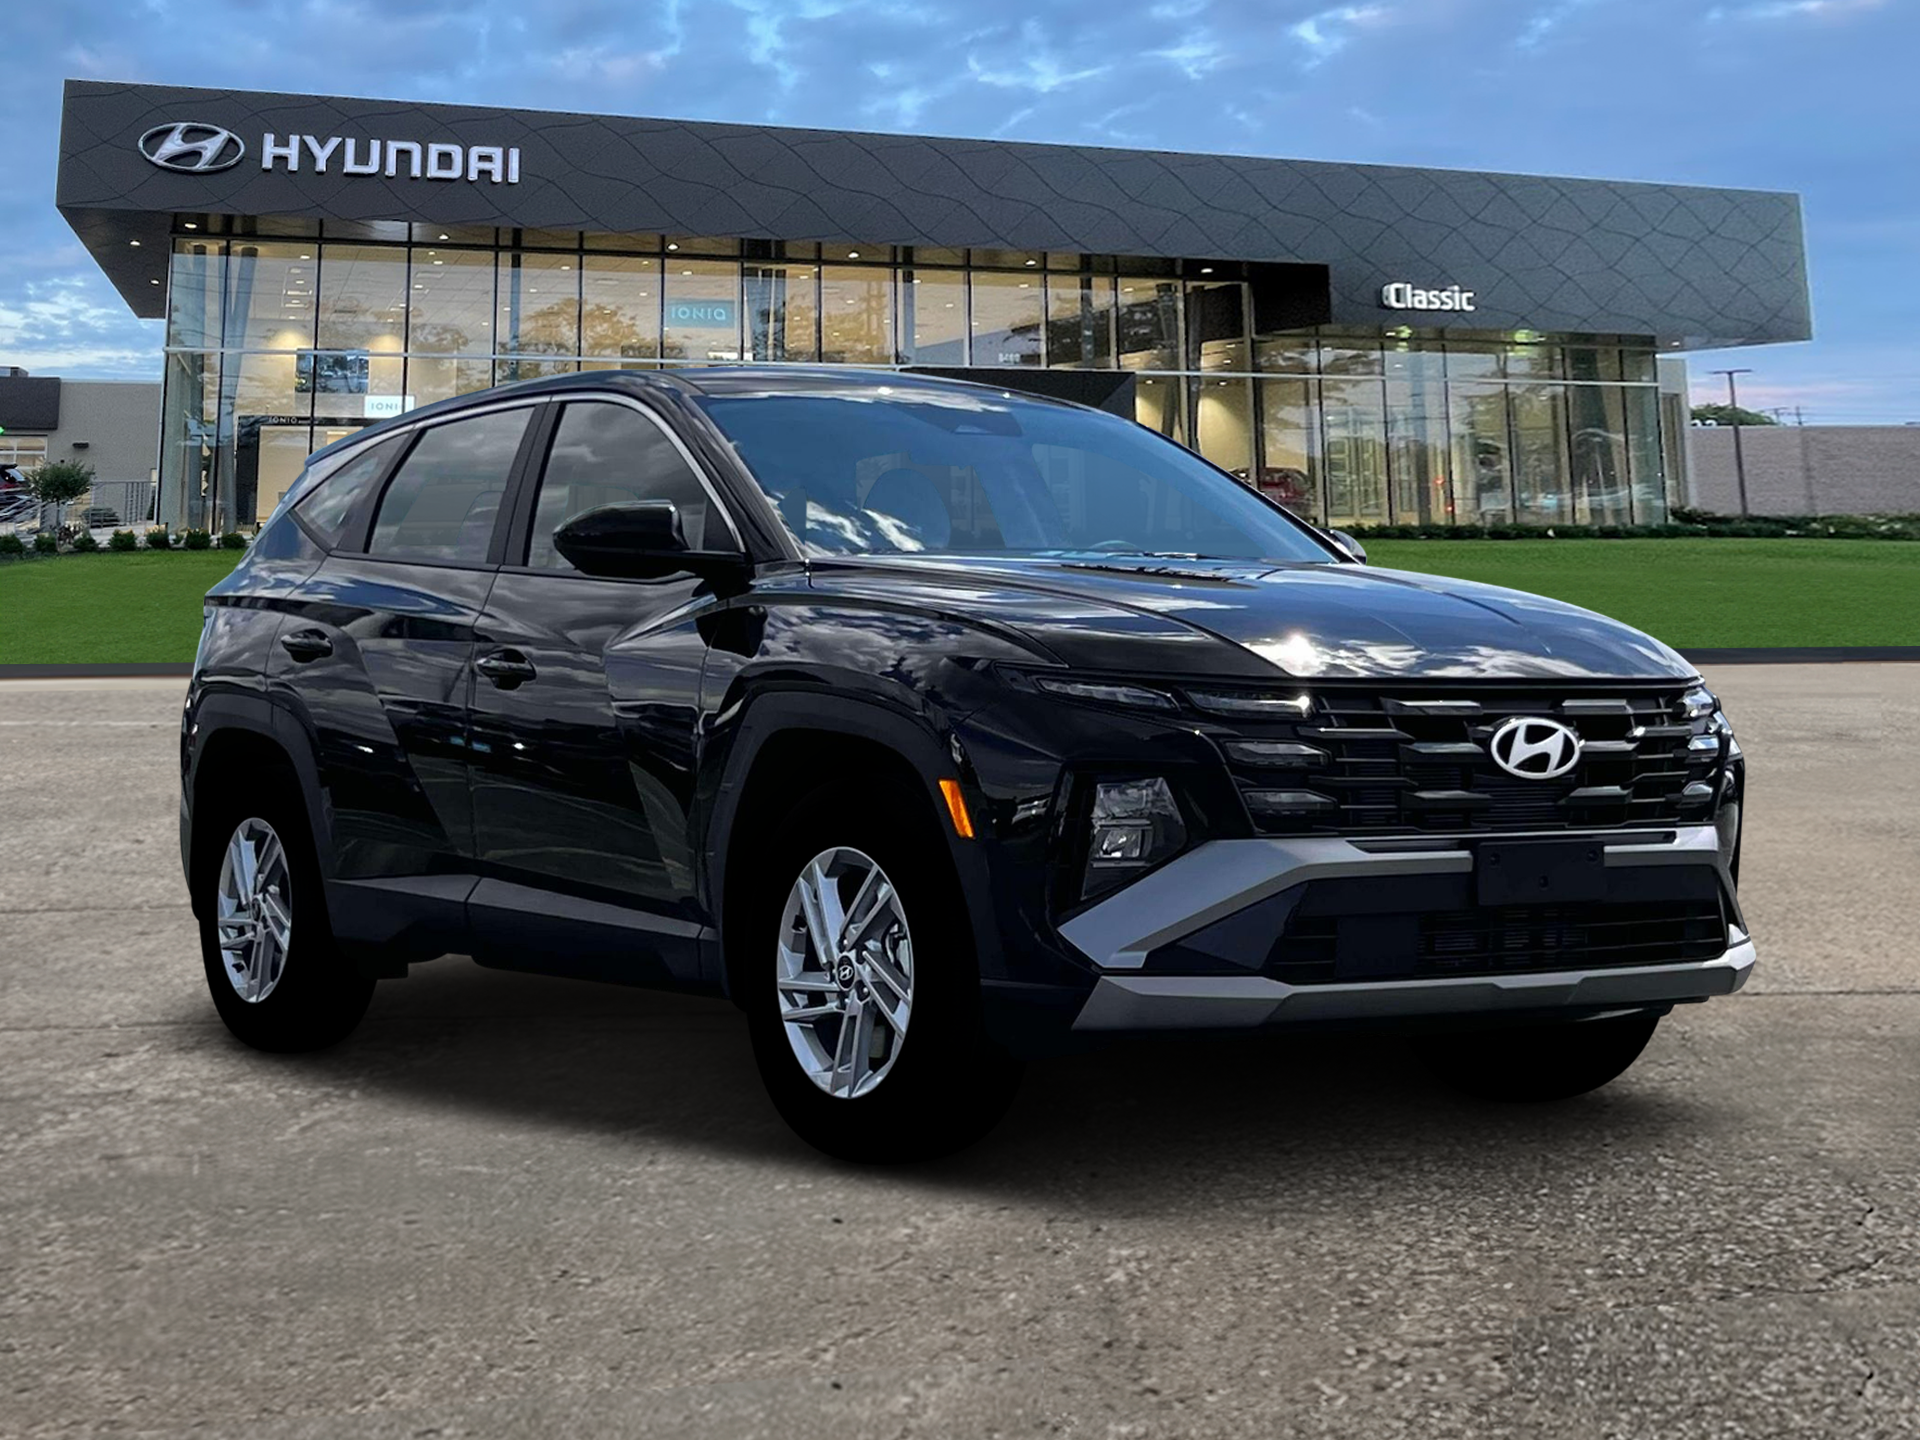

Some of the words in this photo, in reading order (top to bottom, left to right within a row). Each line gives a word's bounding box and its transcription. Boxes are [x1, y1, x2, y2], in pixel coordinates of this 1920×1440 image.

[262, 133, 520, 183] HYUNDAI
[1382, 282, 1476, 312] Classic
[671, 306, 726, 320] IONIQ
[371, 402, 402, 411] IONI
